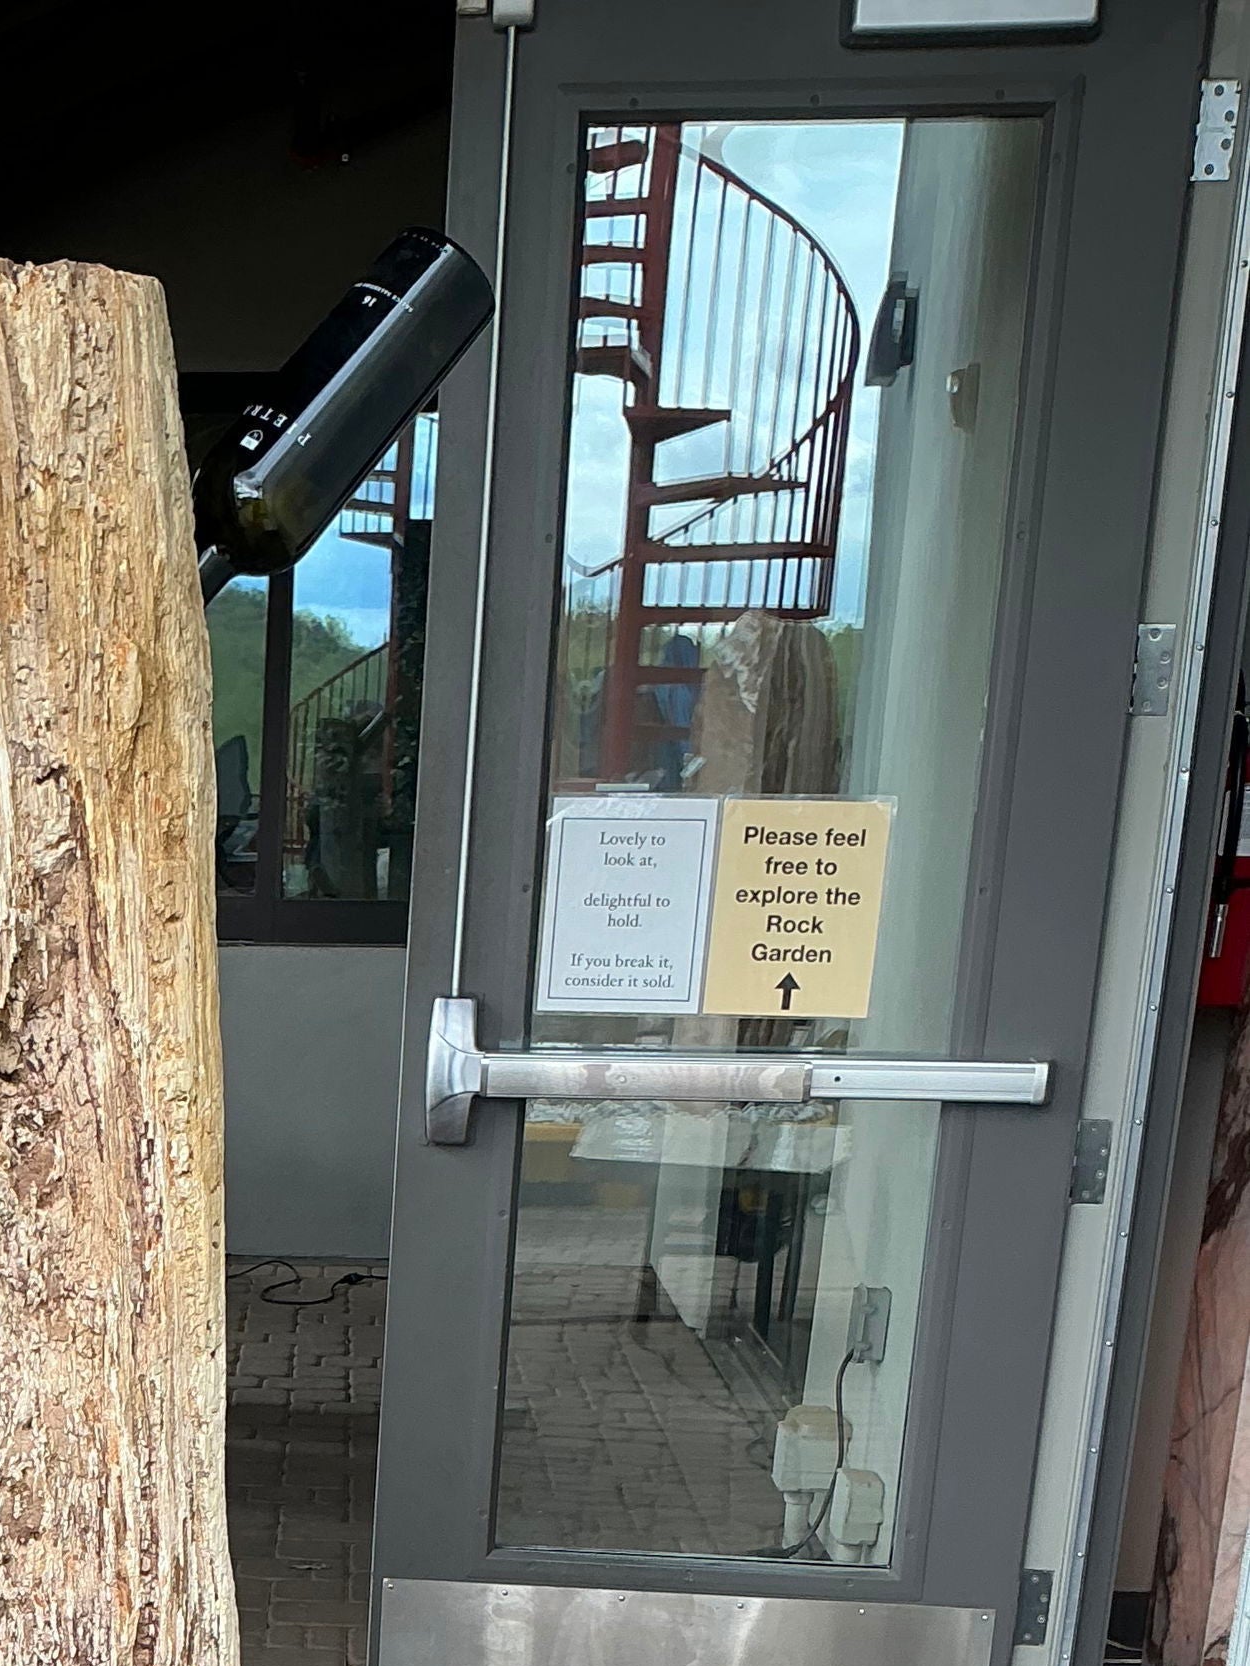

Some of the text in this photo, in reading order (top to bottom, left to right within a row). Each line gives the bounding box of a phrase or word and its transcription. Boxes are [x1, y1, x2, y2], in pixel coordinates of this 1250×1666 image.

[599, 831, 666, 850] Lovely to
[743, 826, 867, 847] Please feel
[603, 851, 657, 869] look at,
[764, 855, 838, 876] free to
[583, 892, 671, 912] delightful to
[735, 885, 861, 908] explore the
[607, 913, 642, 928] hold.
[766, 914, 824, 934] Rock
[570, 952, 673, 971] If you break it,
[751, 943, 832, 963] Garden
[564, 973, 674, 988] consider it sold.
